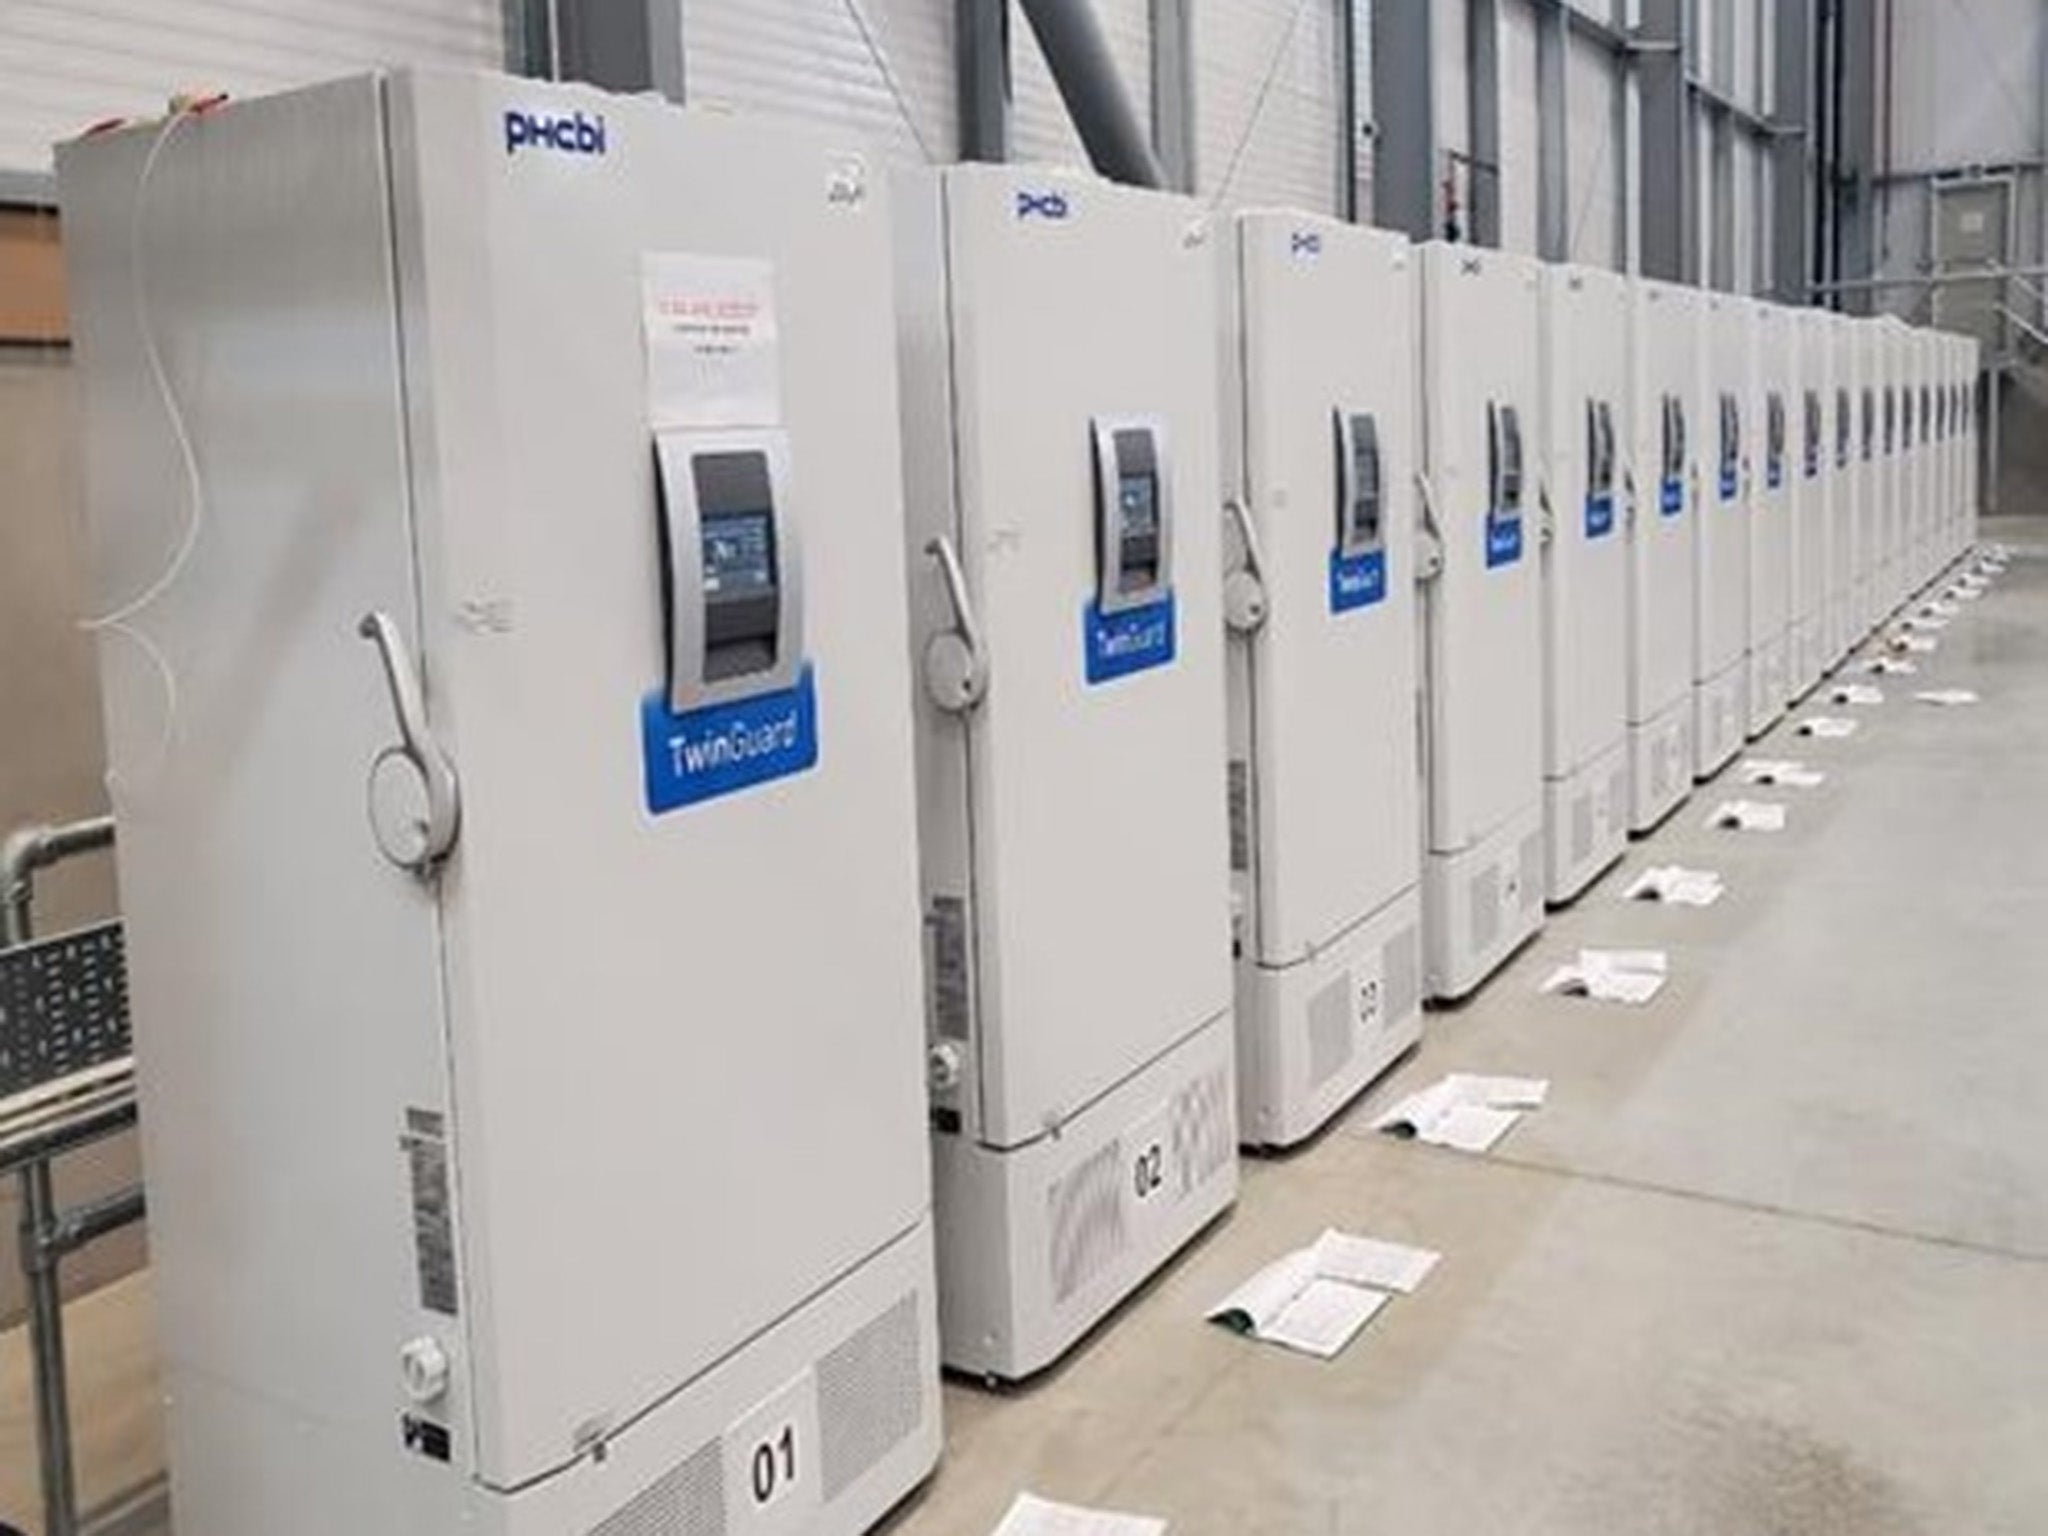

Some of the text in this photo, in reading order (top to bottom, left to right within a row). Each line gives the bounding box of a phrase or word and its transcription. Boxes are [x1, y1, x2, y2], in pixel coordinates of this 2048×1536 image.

[668, 708, 799, 778] TwinGuard
[1134, 1143, 1163, 1199] 02
[753, 1423, 795, 1502] 01
